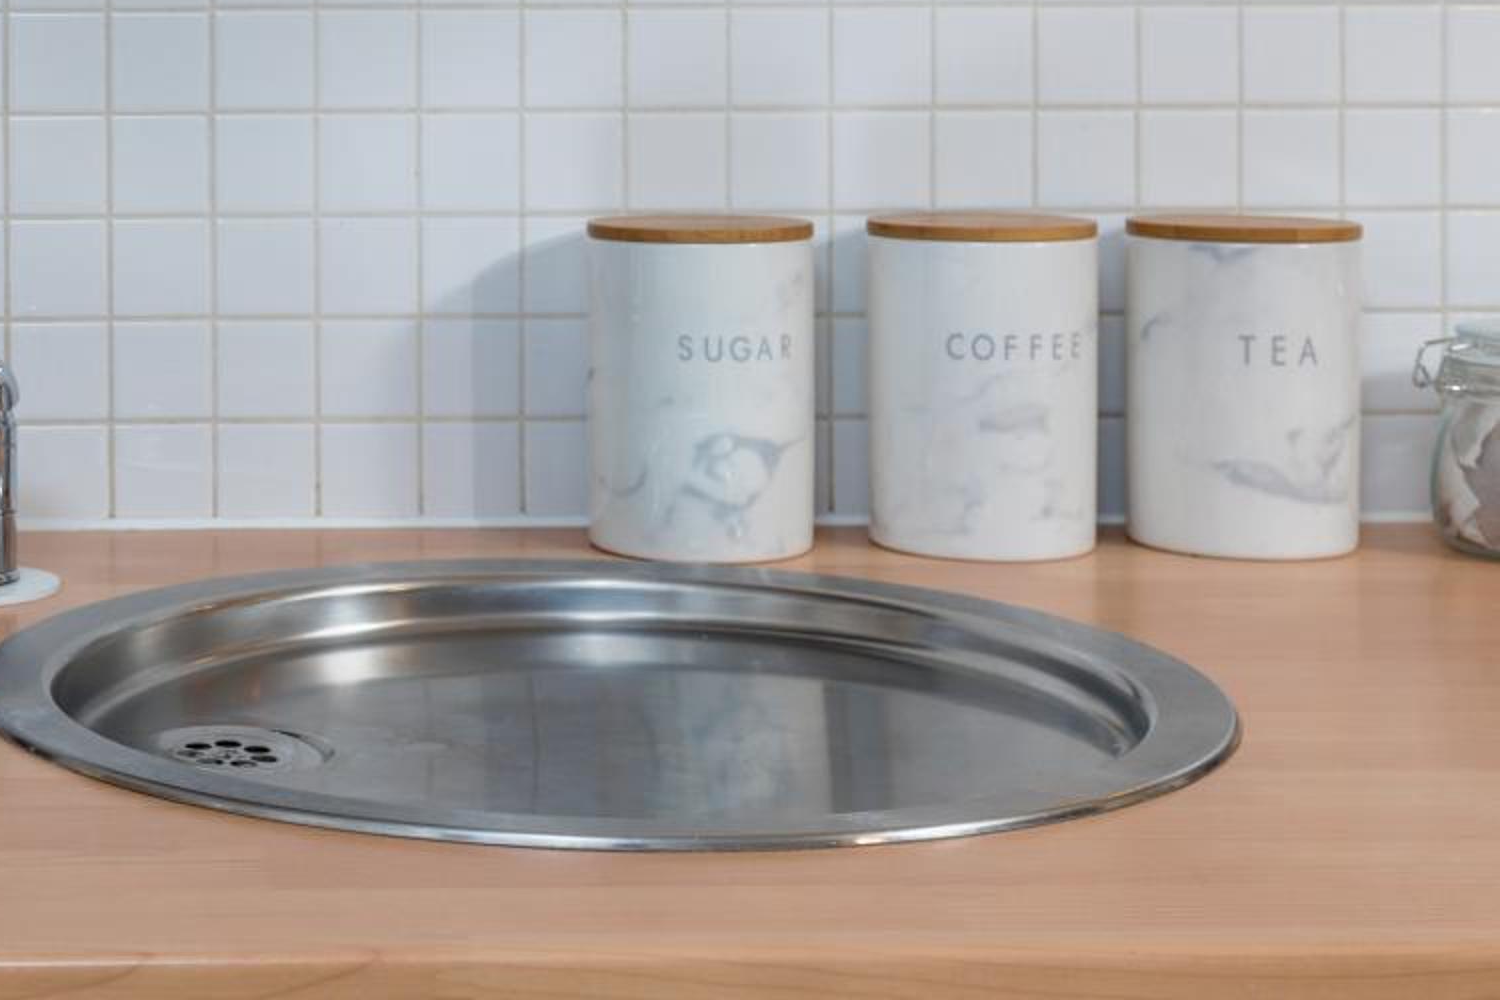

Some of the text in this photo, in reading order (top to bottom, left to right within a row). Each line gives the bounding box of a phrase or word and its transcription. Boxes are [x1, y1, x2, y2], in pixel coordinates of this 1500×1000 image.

[677, 334, 792, 363] SUGAR
[945, 332, 1082, 361] COFFEE
[1238, 334, 1318, 366] TEA
